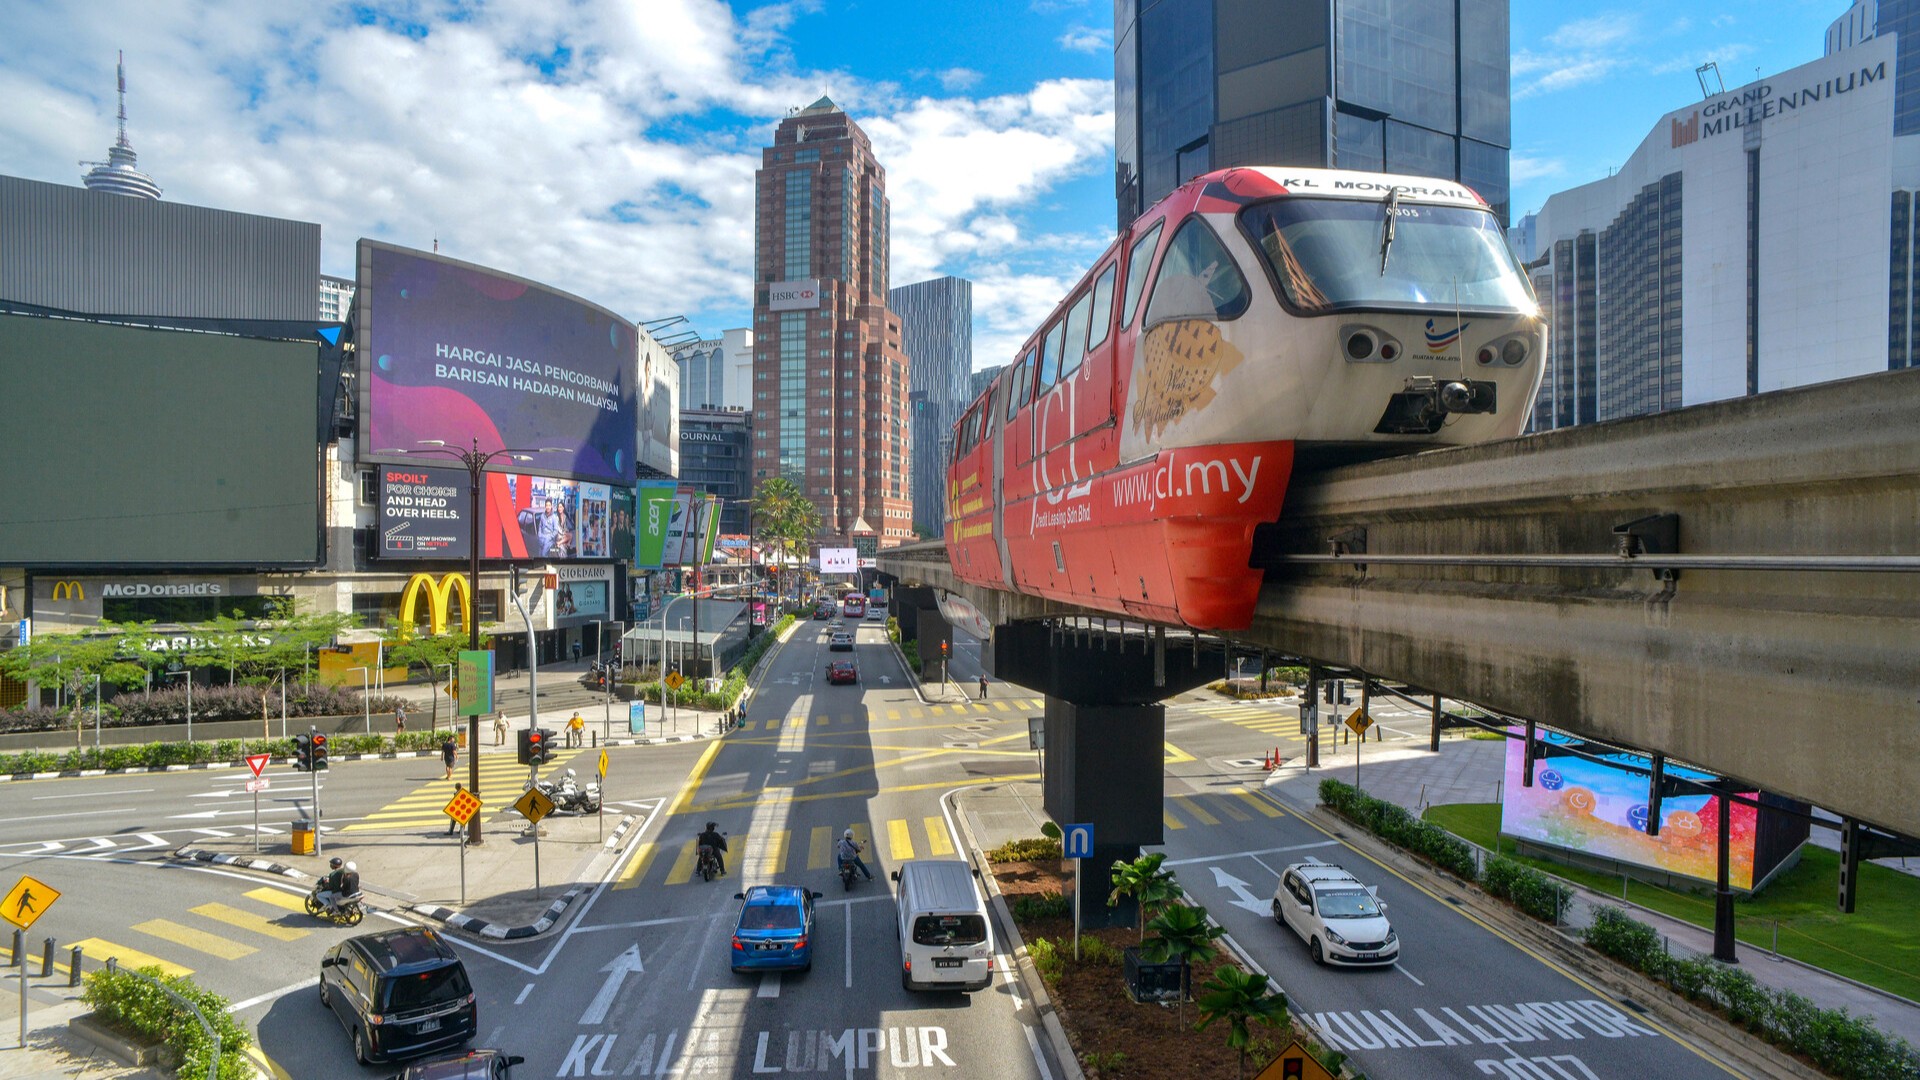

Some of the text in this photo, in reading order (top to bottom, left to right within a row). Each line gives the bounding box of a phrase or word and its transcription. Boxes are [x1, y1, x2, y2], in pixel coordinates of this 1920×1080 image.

[1702, 61, 1886, 139] MILLENNIUM
[1703, 84, 1772, 118] GRAND
[1283, 178, 1473, 200] KL MONORAIL
[772, 290, 799, 301] HSBC
[698, 341, 723, 349] ISTANA
[435, 343, 619, 396] HARGAI JASA PENGORBANAN
[435, 363, 619, 413] BARISAN HADAPAN MALAYSIA
[680, 432, 724, 442] OURNAL
[1029, 369, 1095, 541] JCL
[386, 471, 429, 485] SPOILT
[1112, 452, 1262, 513] www.jcl.my
[386, 483, 457, 498] FOR CHOICE
[386, 495, 447, 507] AND HEAD
[386, 507, 460, 519] OVER HEELS.
[648, 500, 660, 537] acer
[558, 567, 606, 580] GIORDANO
[102, 582, 222, 597] McDonald's
[1303, 1000, 1661, 1052] KUALA LUMPUR
[752, 1025, 957, 1079] LUMPUR
